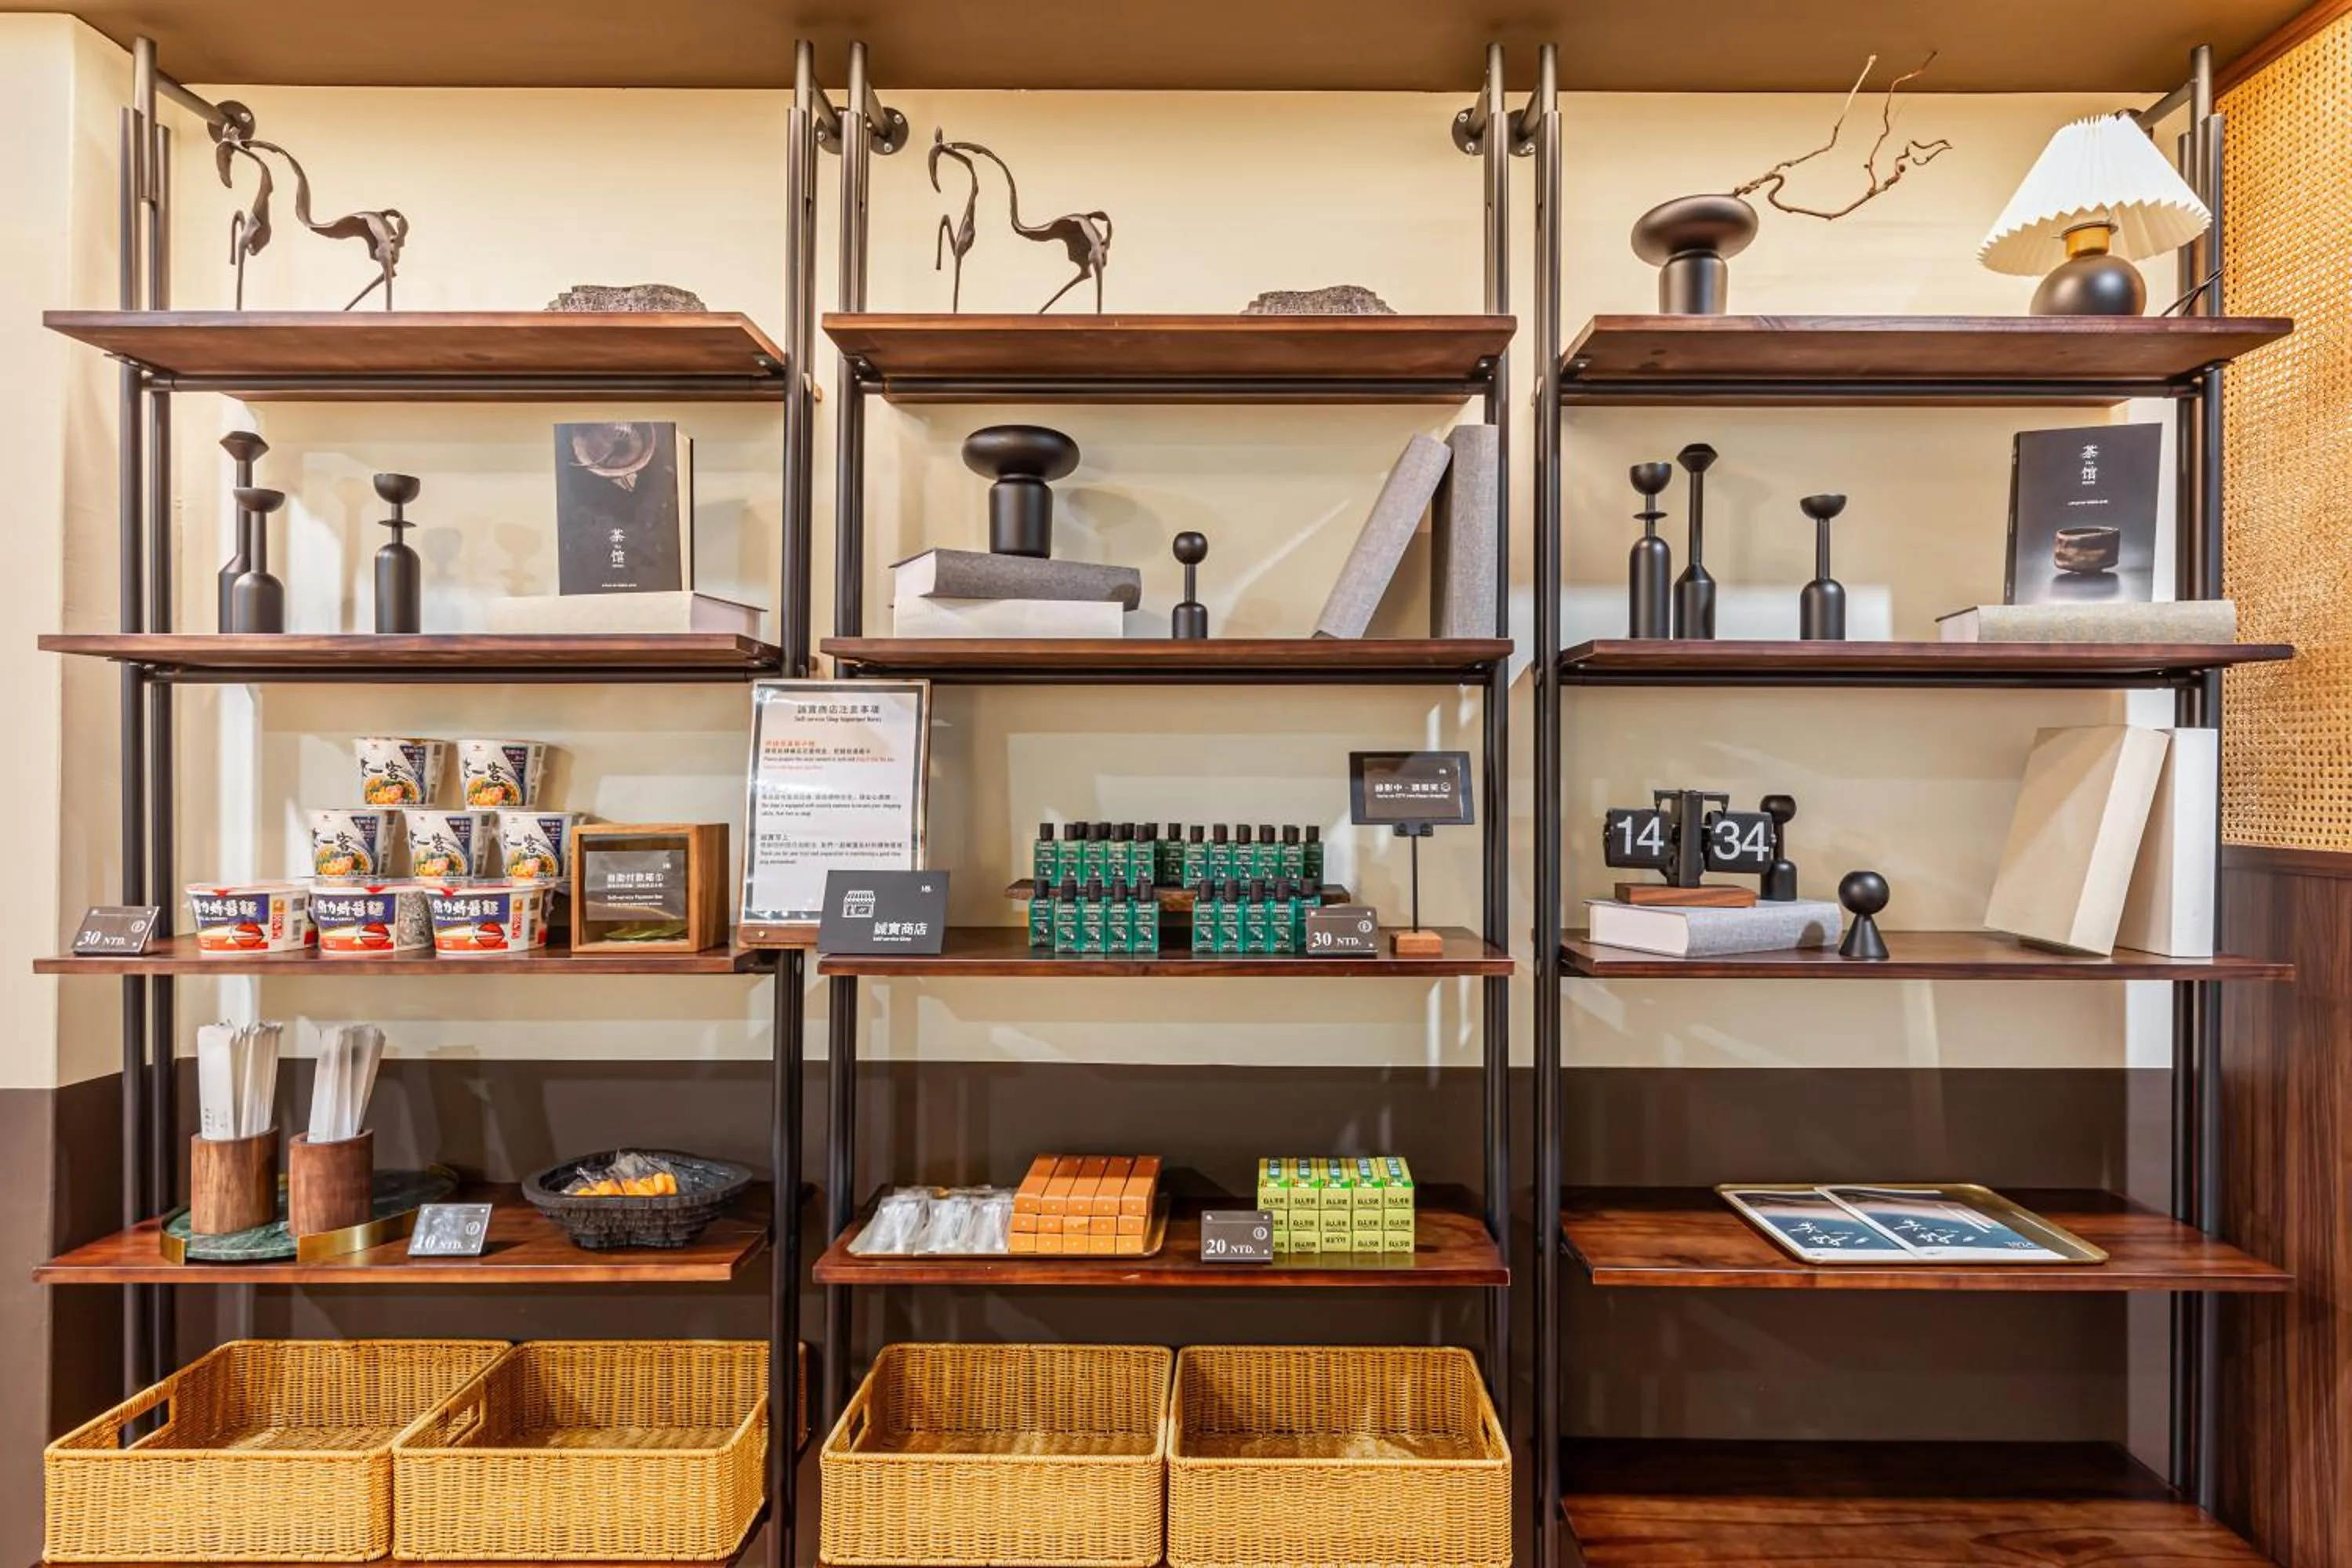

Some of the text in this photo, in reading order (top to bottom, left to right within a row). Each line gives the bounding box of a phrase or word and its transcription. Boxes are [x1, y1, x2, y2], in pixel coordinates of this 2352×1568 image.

[1617, 815, 1769, 862] 14 34
[874, 922, 927, 935] 誠實商店
[78, 931, 101, 944] 30
[1312, 931, 1361, 946] 30 NTD.
[1206, 1239, 1255, 1254] 20 NTD.
